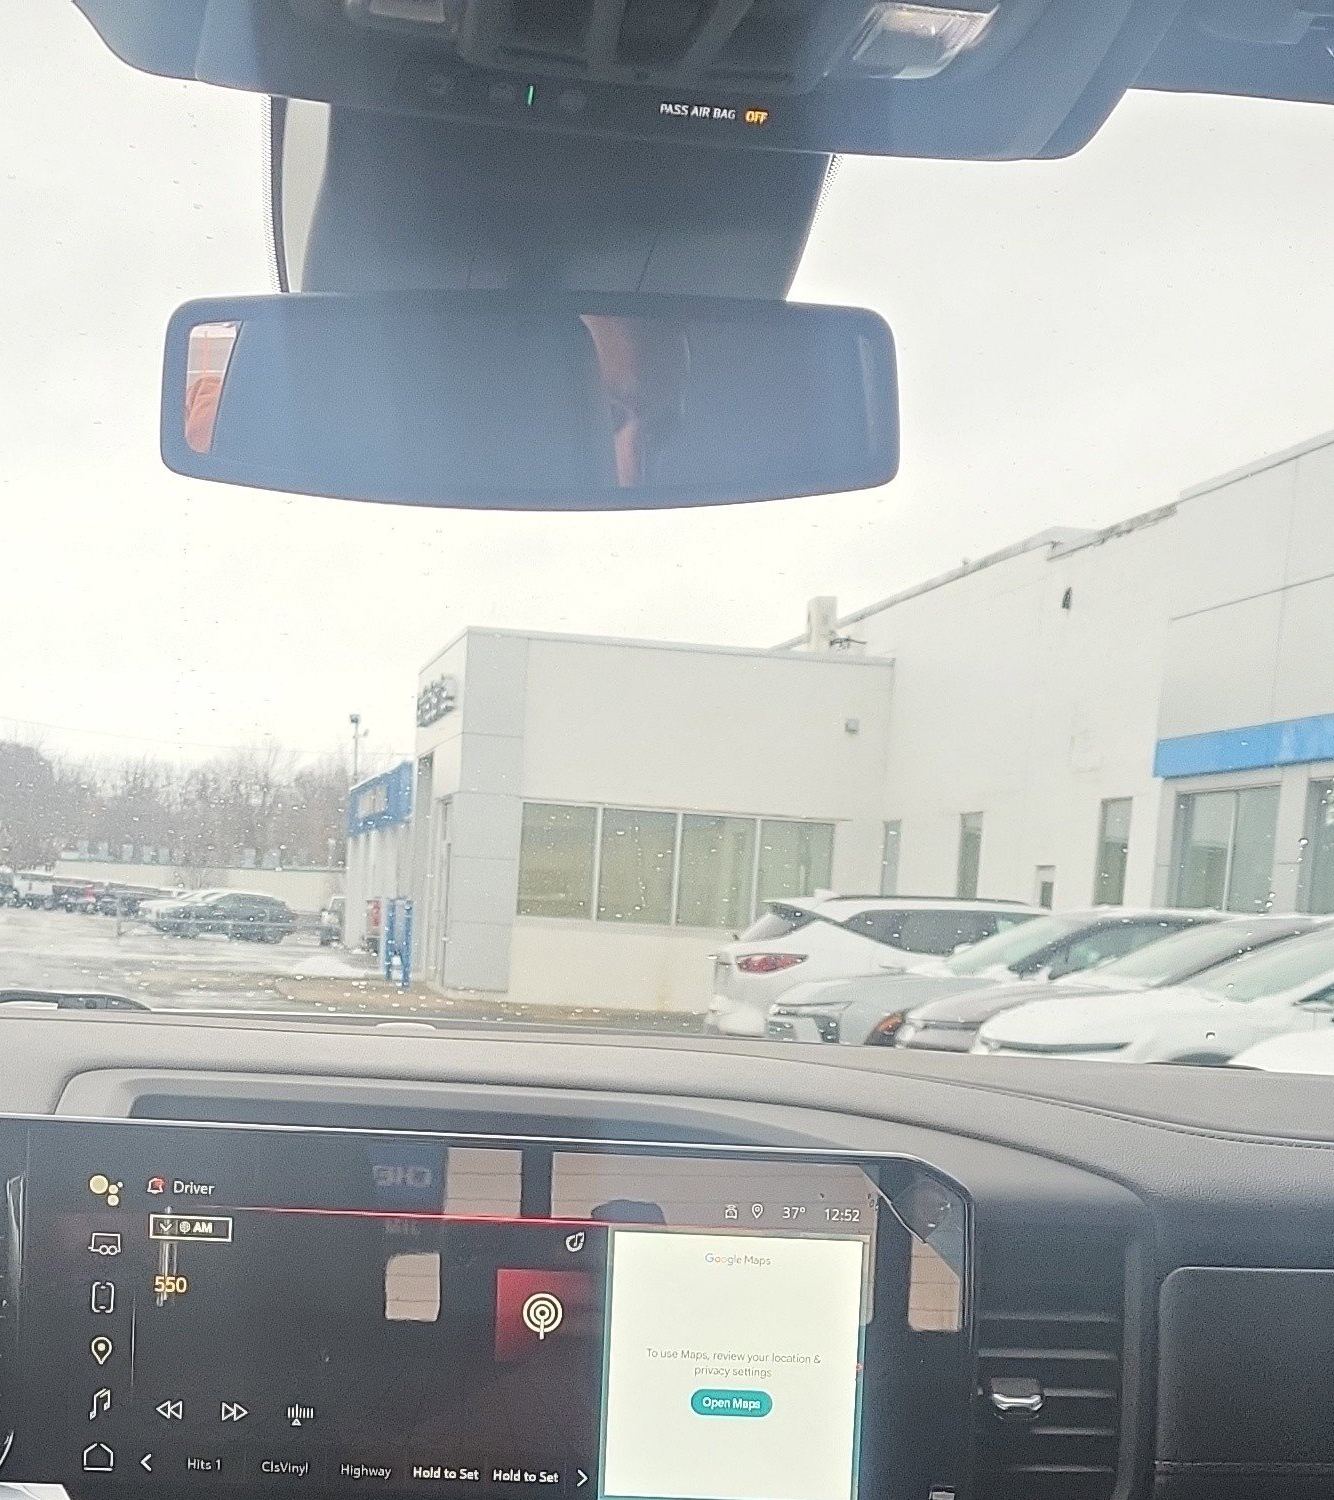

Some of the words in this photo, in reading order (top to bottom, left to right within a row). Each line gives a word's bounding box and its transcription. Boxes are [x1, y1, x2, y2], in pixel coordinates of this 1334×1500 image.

[660, 103, 689, 115] PASS
[690, 105, 711, 118] AIR
[713, 107, 736, 120] BAG
[746, 111, 768, 124] OFF
[173, 1180, 215, 1196] Driver
[782, 1206, 806, 1219] 37°
[825, 1208, 860, 1222] 12:52
[193, 1222, 213, 1234] AM
[705, 1253, 742, 1266] Google
[744, 1254, 771, 1266] Maps
[154, 1276, 188, 1294] 550
[647, 1348, 658, 1358] To
[660, 1350, 678, 1359] use
[681, 1349, 710, 1362] Maps,
[713, 1350, 746, 1361] review
[747, 1353, 769, 1364] your
[772, 1352, 811, 1364] location
[814, 1354, 822, 1364] &
[694, 1366, 730, 1378] privacy
[732, 1366, 773, 1379] settings
[702, 1396, 730, 1411] Open
[732, 1397, 761, 1412] Maps
[187, 1457, 212, 1471] Hits
[215, 1458, 222, 1471] 1
[261, 1460, 309, 1475] ClsVinyl
[340, 1464, 391, 1480] Highway
[413, 1466, 441, 1480] Hold
[444, 1469, 457, 1480] to
[459, 1468, 479, 1482] Set
[493, 1469, 521, 1483] Hold
[524, 1471, 537, 1483] to
[538, 1470, 559, 1484] Set
